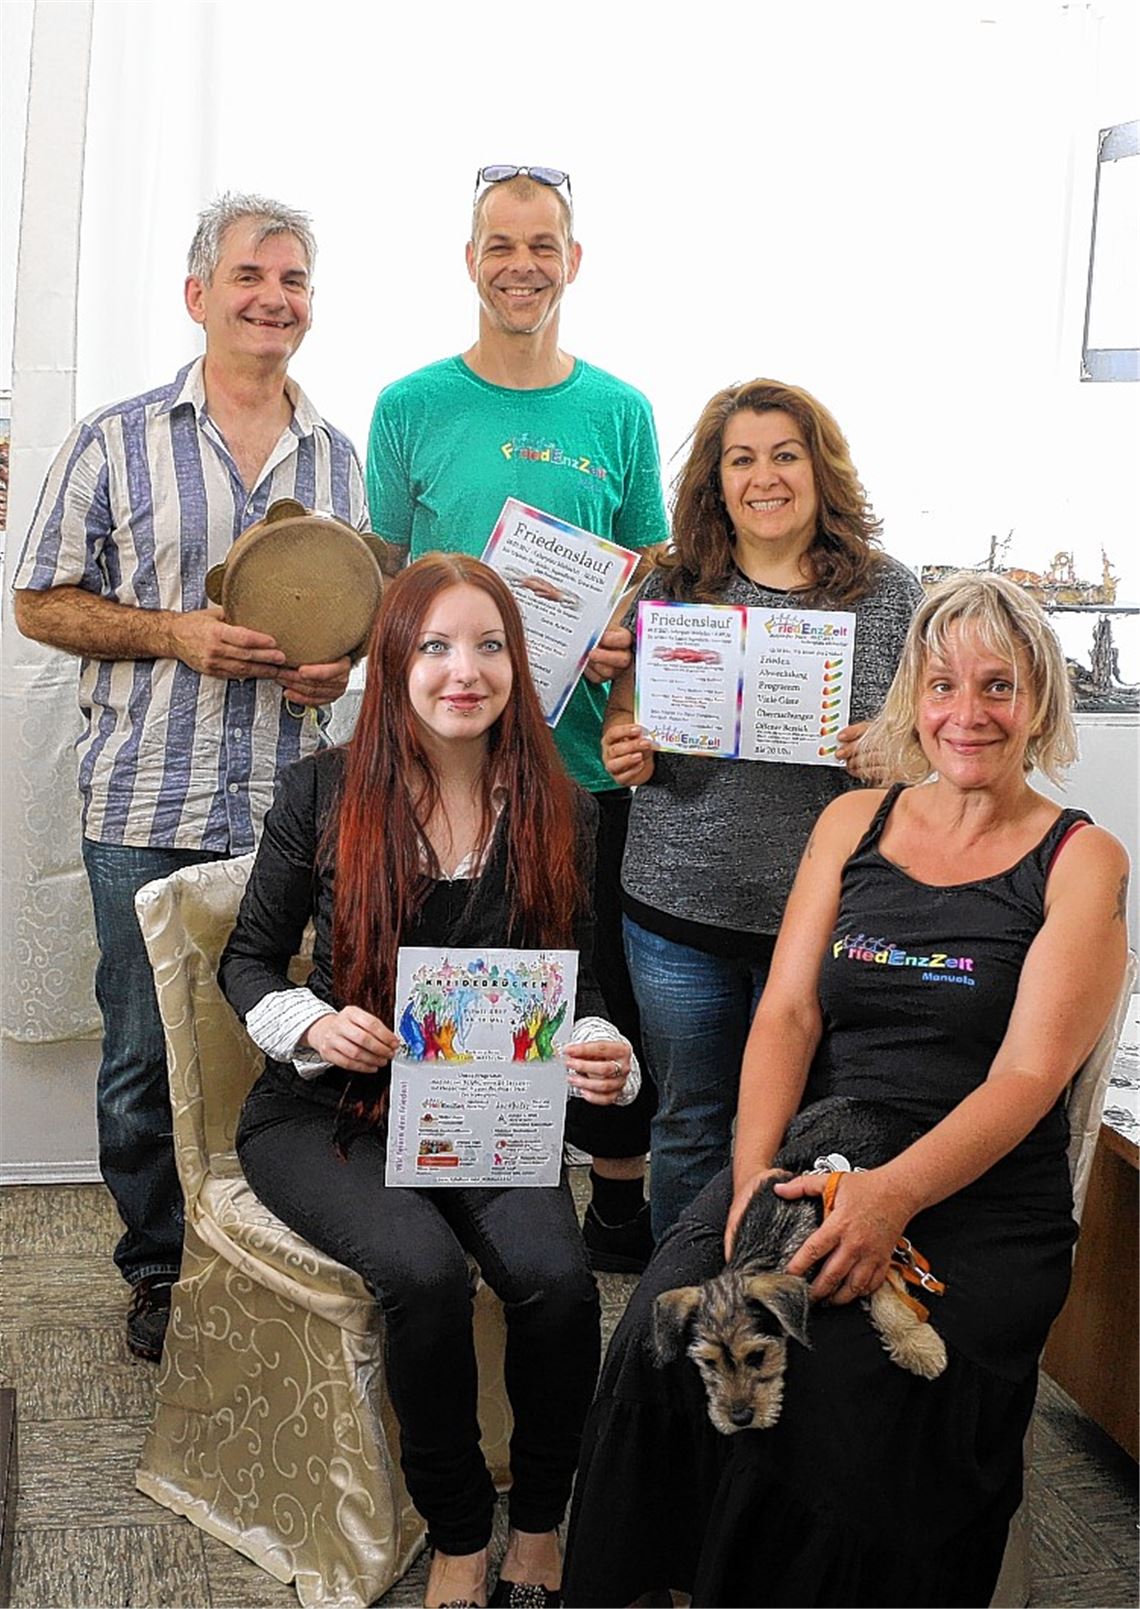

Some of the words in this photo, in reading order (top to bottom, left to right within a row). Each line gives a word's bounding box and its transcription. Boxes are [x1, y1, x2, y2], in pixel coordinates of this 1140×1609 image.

[513, 522, 614, 576] Friedenslauf
[651, 612, 733, 629] Friedenslauf
[759, 681, 801, 692] Programm
[426, 978, 548, 989] KREIDEBRÜCKEN
[922, 972, 976, 986] Manuela
